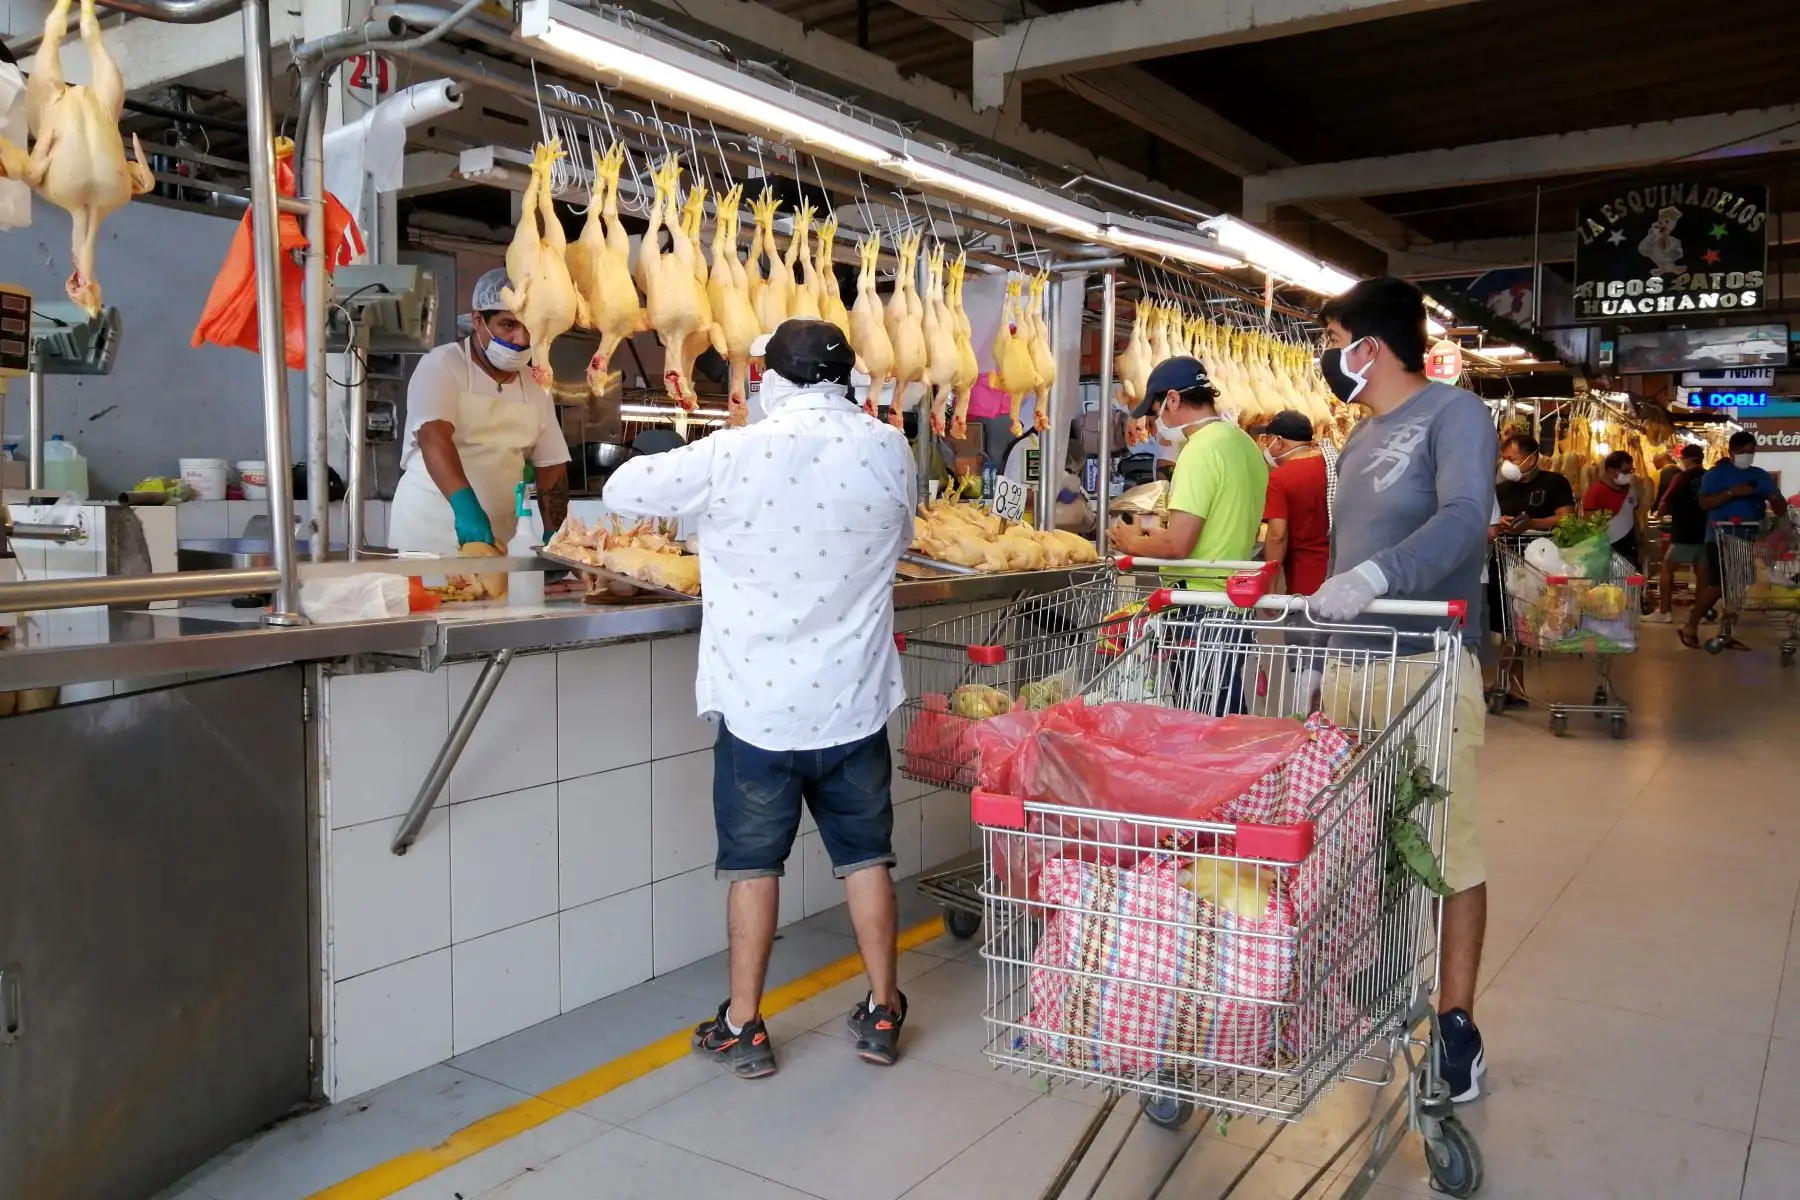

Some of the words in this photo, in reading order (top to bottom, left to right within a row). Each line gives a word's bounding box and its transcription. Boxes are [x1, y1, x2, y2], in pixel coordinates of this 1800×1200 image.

[1576, 217, 1606, 246] LA
[1575, 276, 1664, 300] RICOS
[1668, 270, 1764, 292] PATOS
[1583, 290, 1758, 316] HUACHANOS
